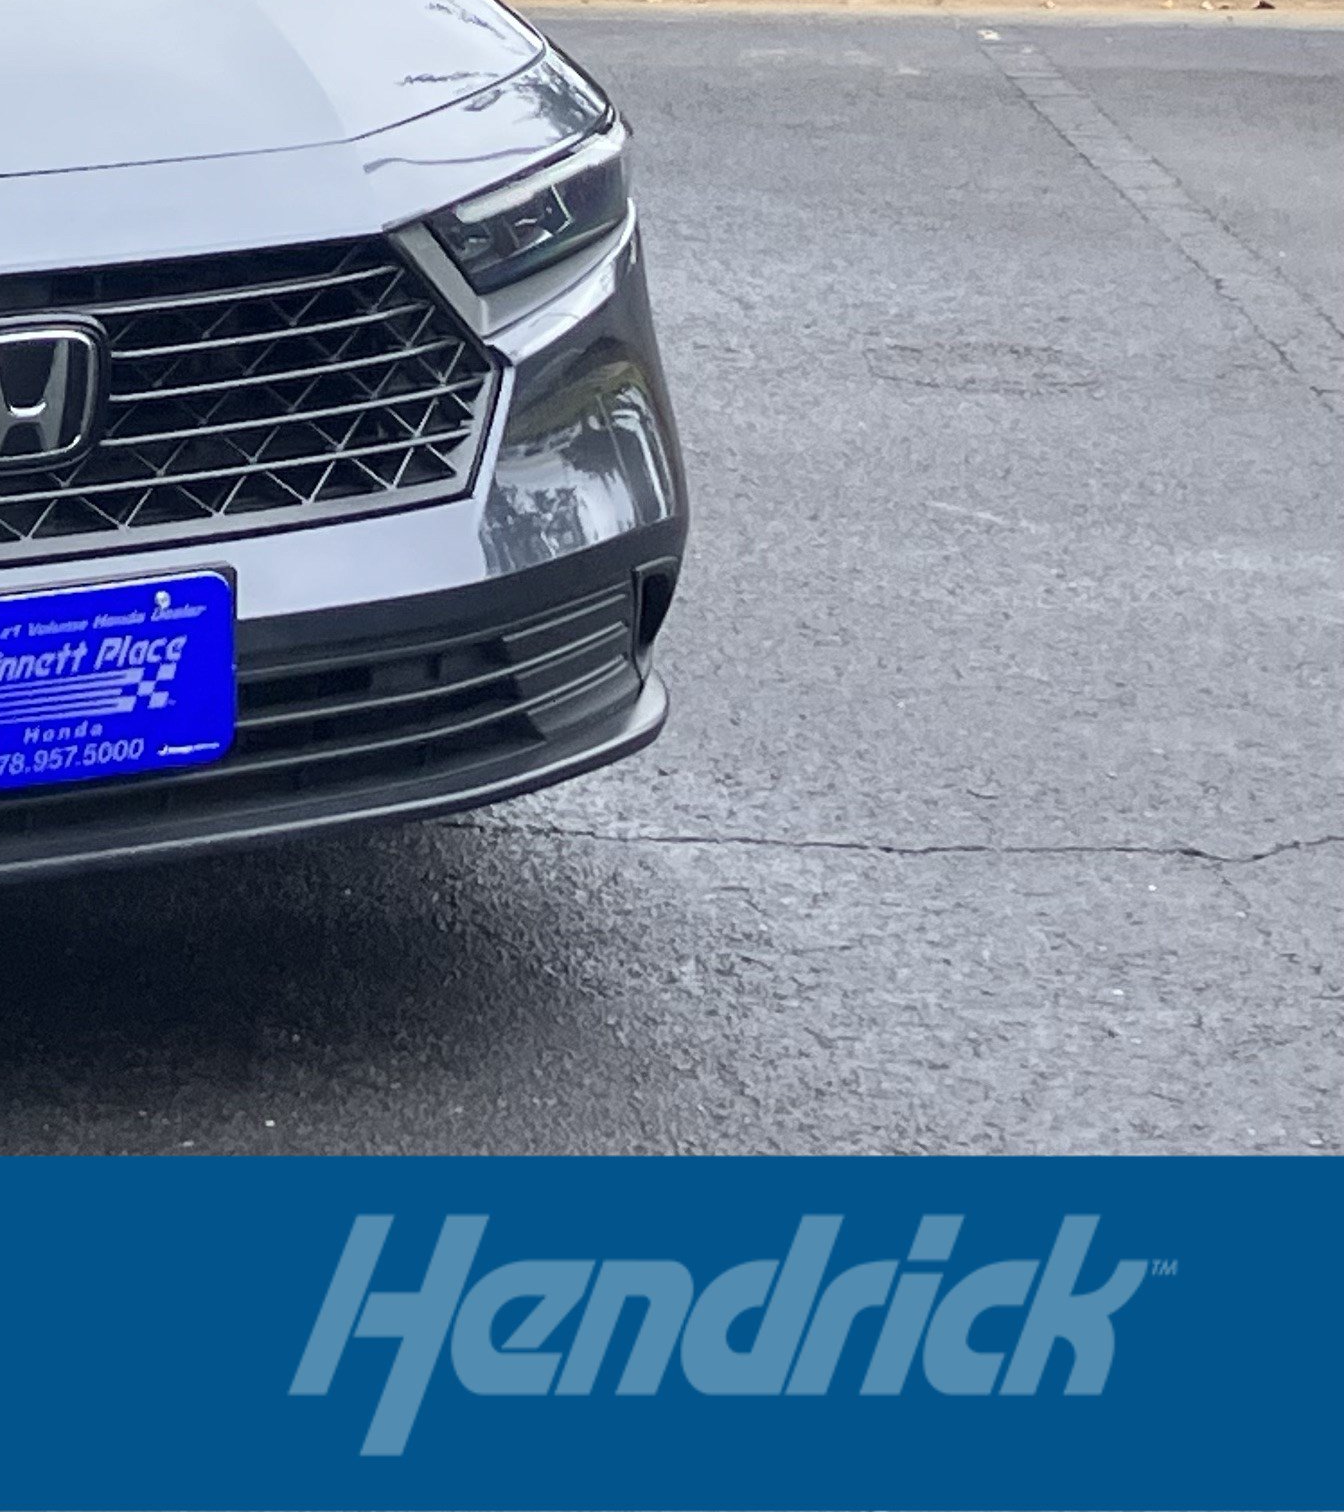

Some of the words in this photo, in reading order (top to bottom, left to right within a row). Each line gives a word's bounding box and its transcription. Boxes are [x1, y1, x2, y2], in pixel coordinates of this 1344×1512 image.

[92, 609, 147, 630] Honda
[93, 634, 188, 671] Place
[22, 719, 104, 746] Honda
